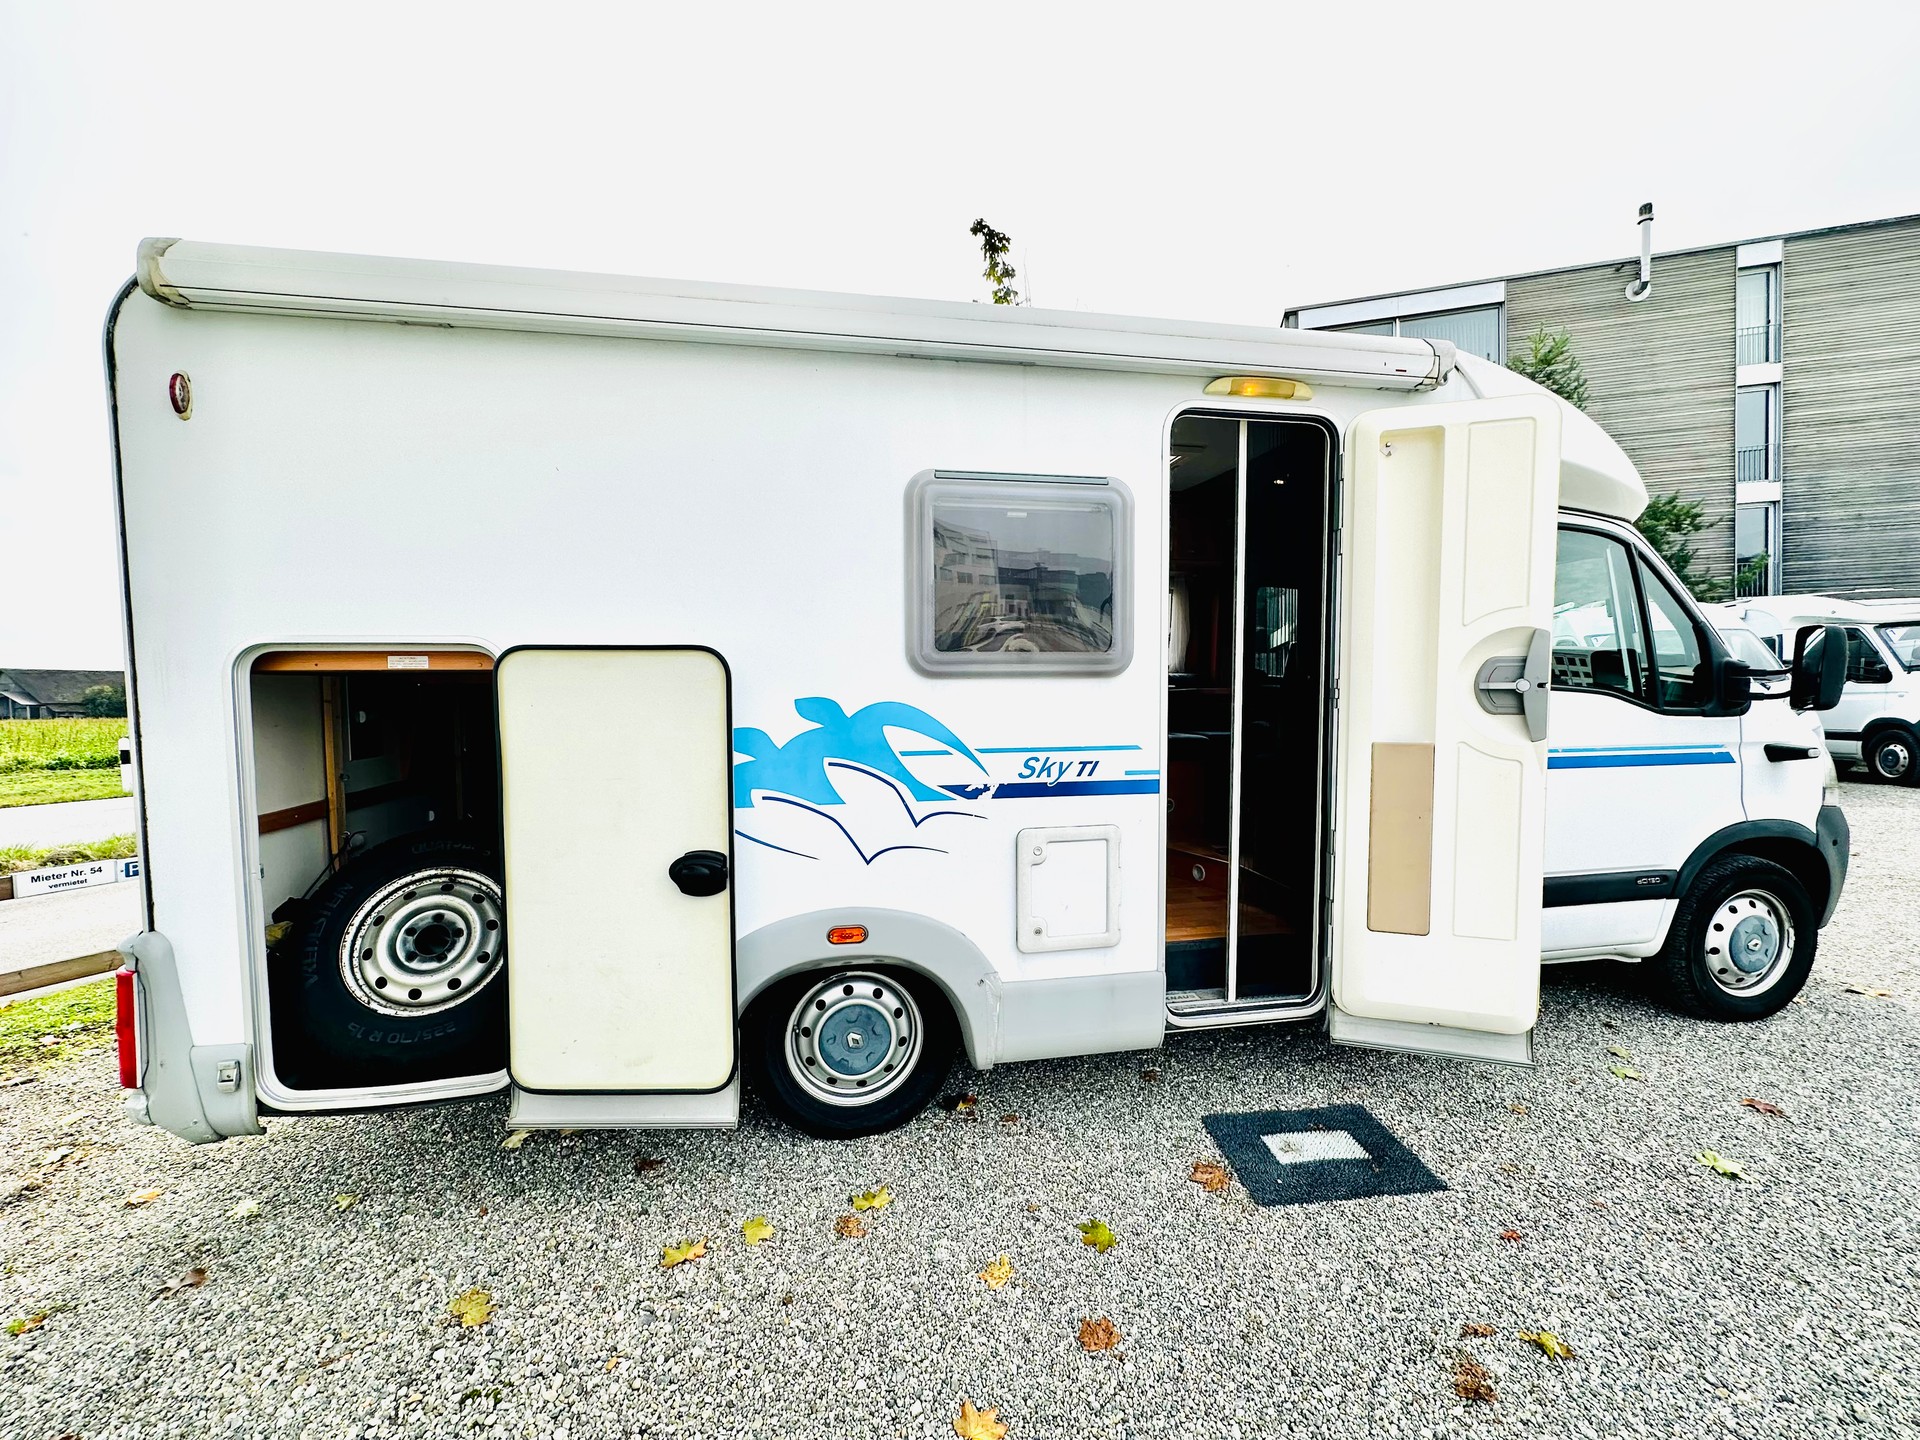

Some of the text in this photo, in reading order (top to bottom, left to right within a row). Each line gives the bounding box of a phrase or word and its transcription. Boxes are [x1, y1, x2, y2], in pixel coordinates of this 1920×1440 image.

[1017, 756, 1100, 786] Sky TI
[30, 866, 103, 883] Mieter Nr. 54
[48, 878, 88, 889] vermietet
[368, 1030, 384, 1043] R
[387, 1020, 457, 1044] 225/70
